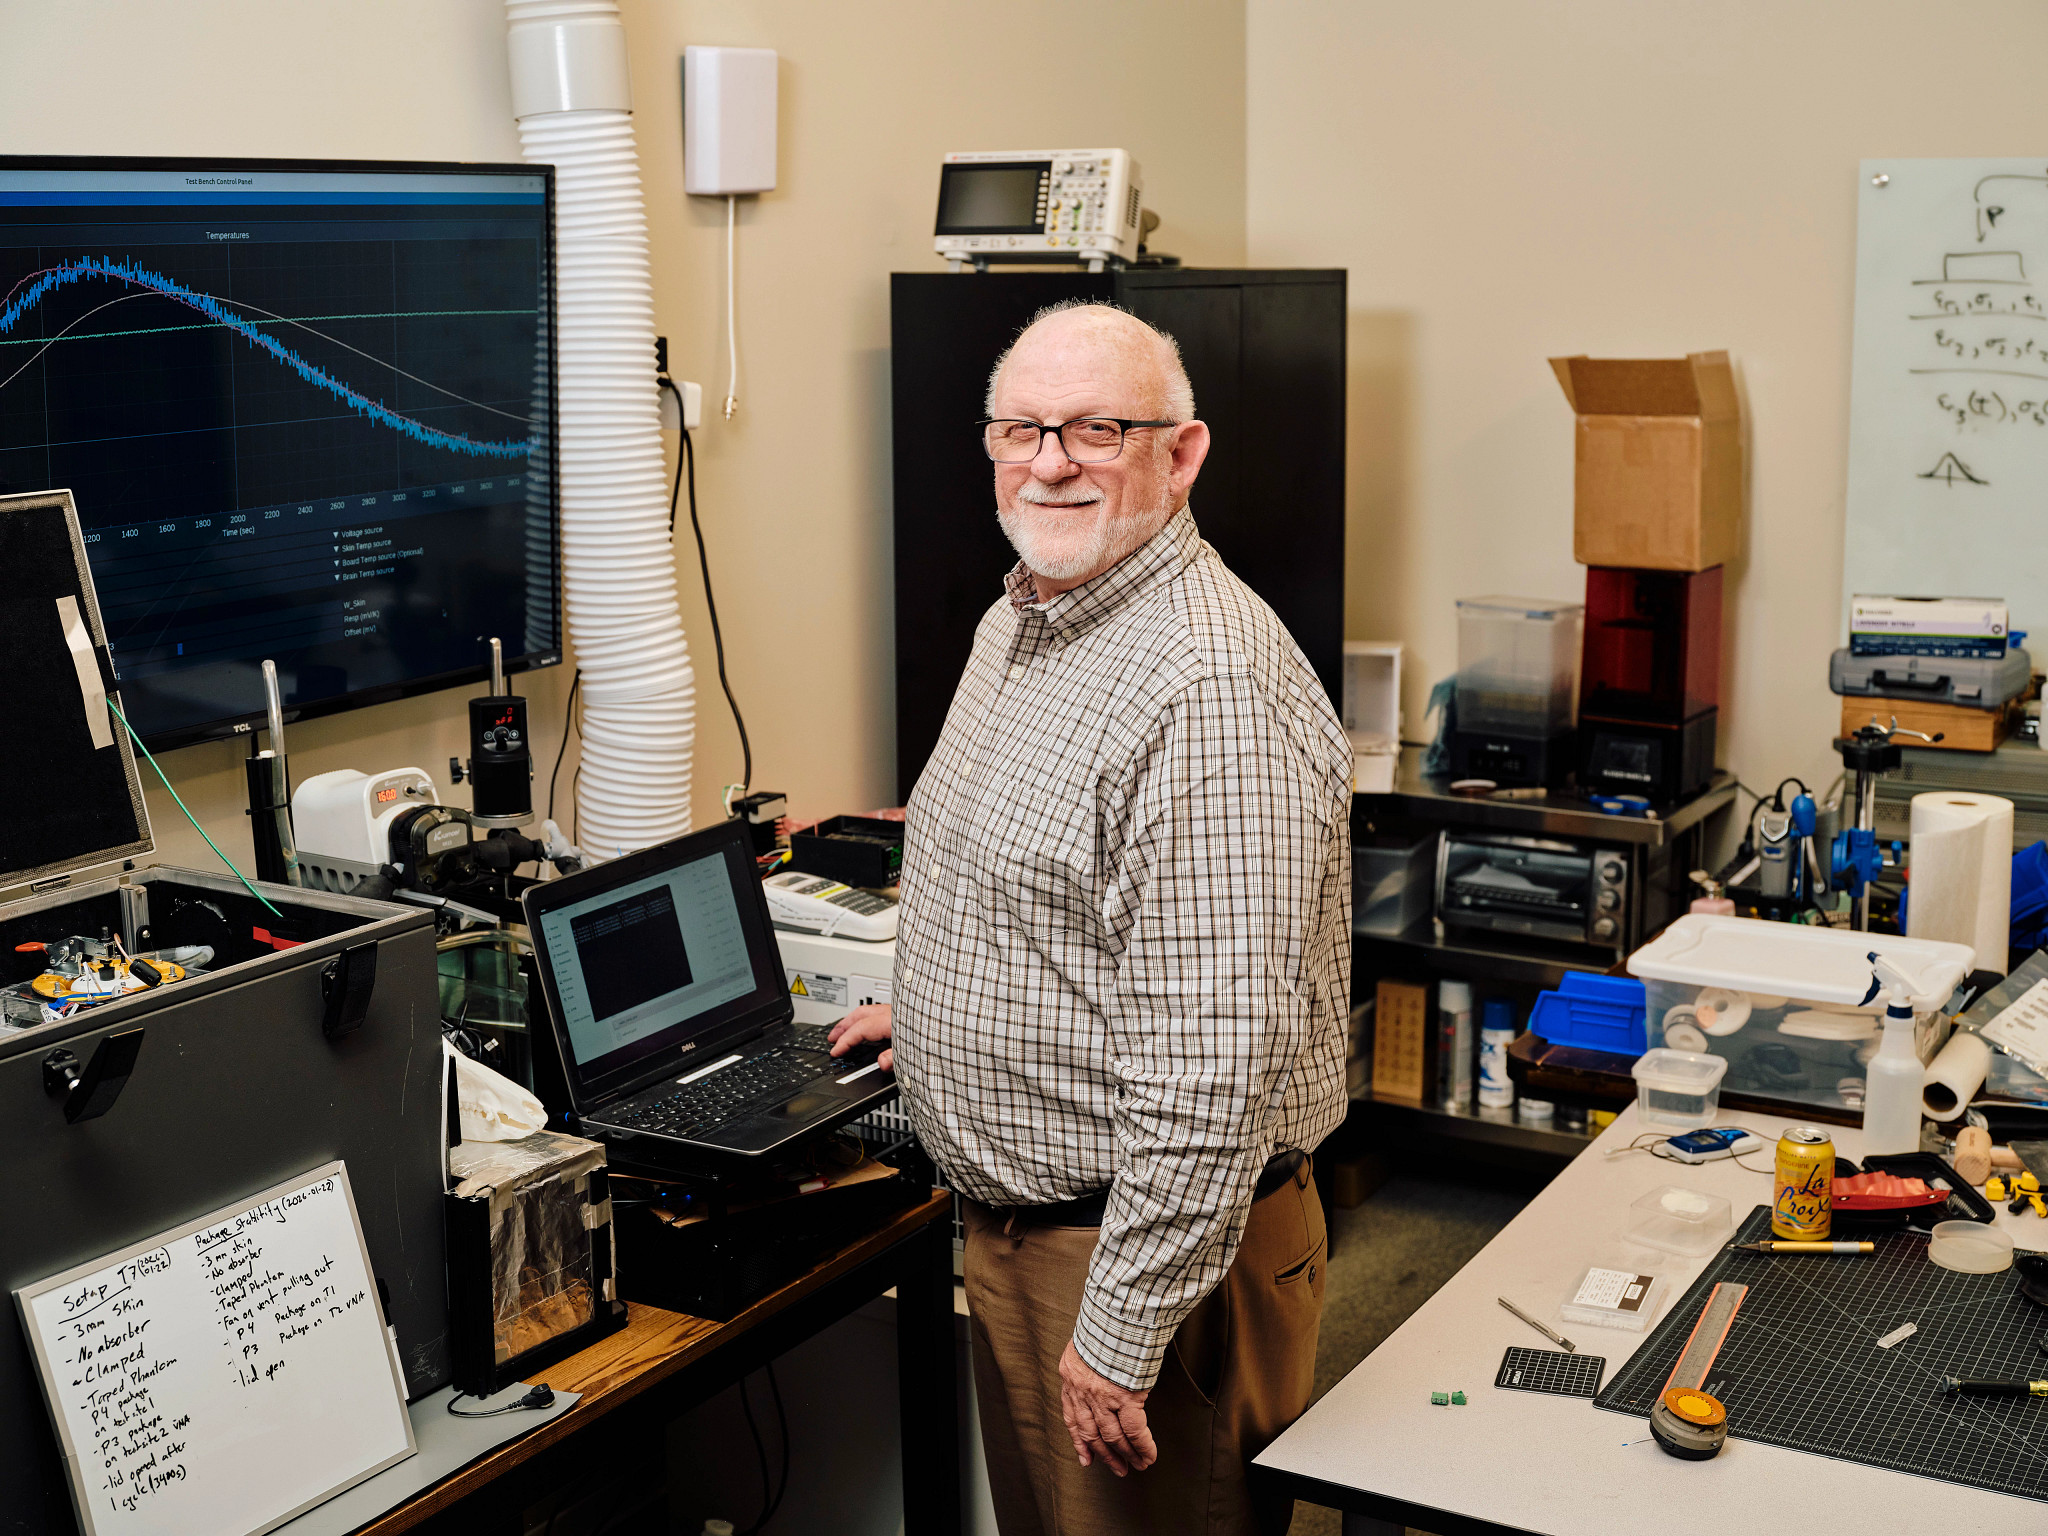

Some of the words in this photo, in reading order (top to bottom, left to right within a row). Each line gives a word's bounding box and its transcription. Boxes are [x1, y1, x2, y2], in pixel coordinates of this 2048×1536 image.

[1986, 205, 2005, 228] P
[205, 231, 250, 241] Temperatures
[83, 533, 101, 544] 1200
[121, 528, 139, 539] 1400
[159, 523, 176, 534] 1600
[195, 518, 211, 529] 1800
[230, 514, 246, 524] 2000
[264, 509, 280, 519] 2200
[297, 505, 313, 515] 2400
[330, 501, 345, 510] 2600
[361, 497, 376, 506] 2800
[392, 493, 407, 502] 3000
[422, 488, 436, 498] 3200
[451, 485, 465, 495] 3400
[222, 528, 238, 537] Time
[239, 525, 255, 537] (sec)
[341, 529, 363, 538] Voltage
[364, 526, 383, 535] source
[341, 544, 355, 553] Skin
[355, 542, 372, 551] Temp
[373, 540, 392, 548] source
[342, 558, 360, 567] Board
[361, 555, 377, 563] Temp
[377, 552, 396, 560] source
[396, 547, 424, 560] (Optional)
[342, 573, 358, 581] Brain
[359, 569, 375, 578] Temp
[375, 567, 395, 575] source
[343, 599, 366, 610] W_Skin
[343, 614, 359, 623] Resp
[344, 628, 362, 637] Offset
[362, 624, 377, 635] (mV)
[233, 722, 252, 733] TCL
[681, 1041, 697, 1053] DELL
[1798, 1163, 1825, 1198] La
[1775, 1186, 1830, 1223] Croix
[195, 1227, 233, 1248] Package
[232, 1237, 253, 1254] skin
[228, 1247, 263, 1271] absorber
[282, 1273, 314, 1297] pulling
[314, 1254, 334, 1278] out
[63, 1284, 108, 1312] Setup
[117, 1264, 137, 1285] T7
[310, 1297, 322, 1308] on
[313, 1318, 323, 1328] on
[328, 1306, 344, 1318] T2
[346, 1290, 366, 1310] VNA
[78, 1345, 93, 1364] No
[97, 1319, 151, 1354] absorber
[85, 1341, 145, 1383] Clamped
[130, 1358, 178, 1386] Phantom
[265, 1360, 286, 1382] open
[117, 1387, 149, 1413] package
[94, 1426, 107, 1438] on
[128, 1414, 163, 1442] package
[105, 1455, 118, 1468] on
[130, 1452, 158, 1482] opened
[161, 1441, 187, 1461] after
[122, 1481, 149, 1512] cycle
